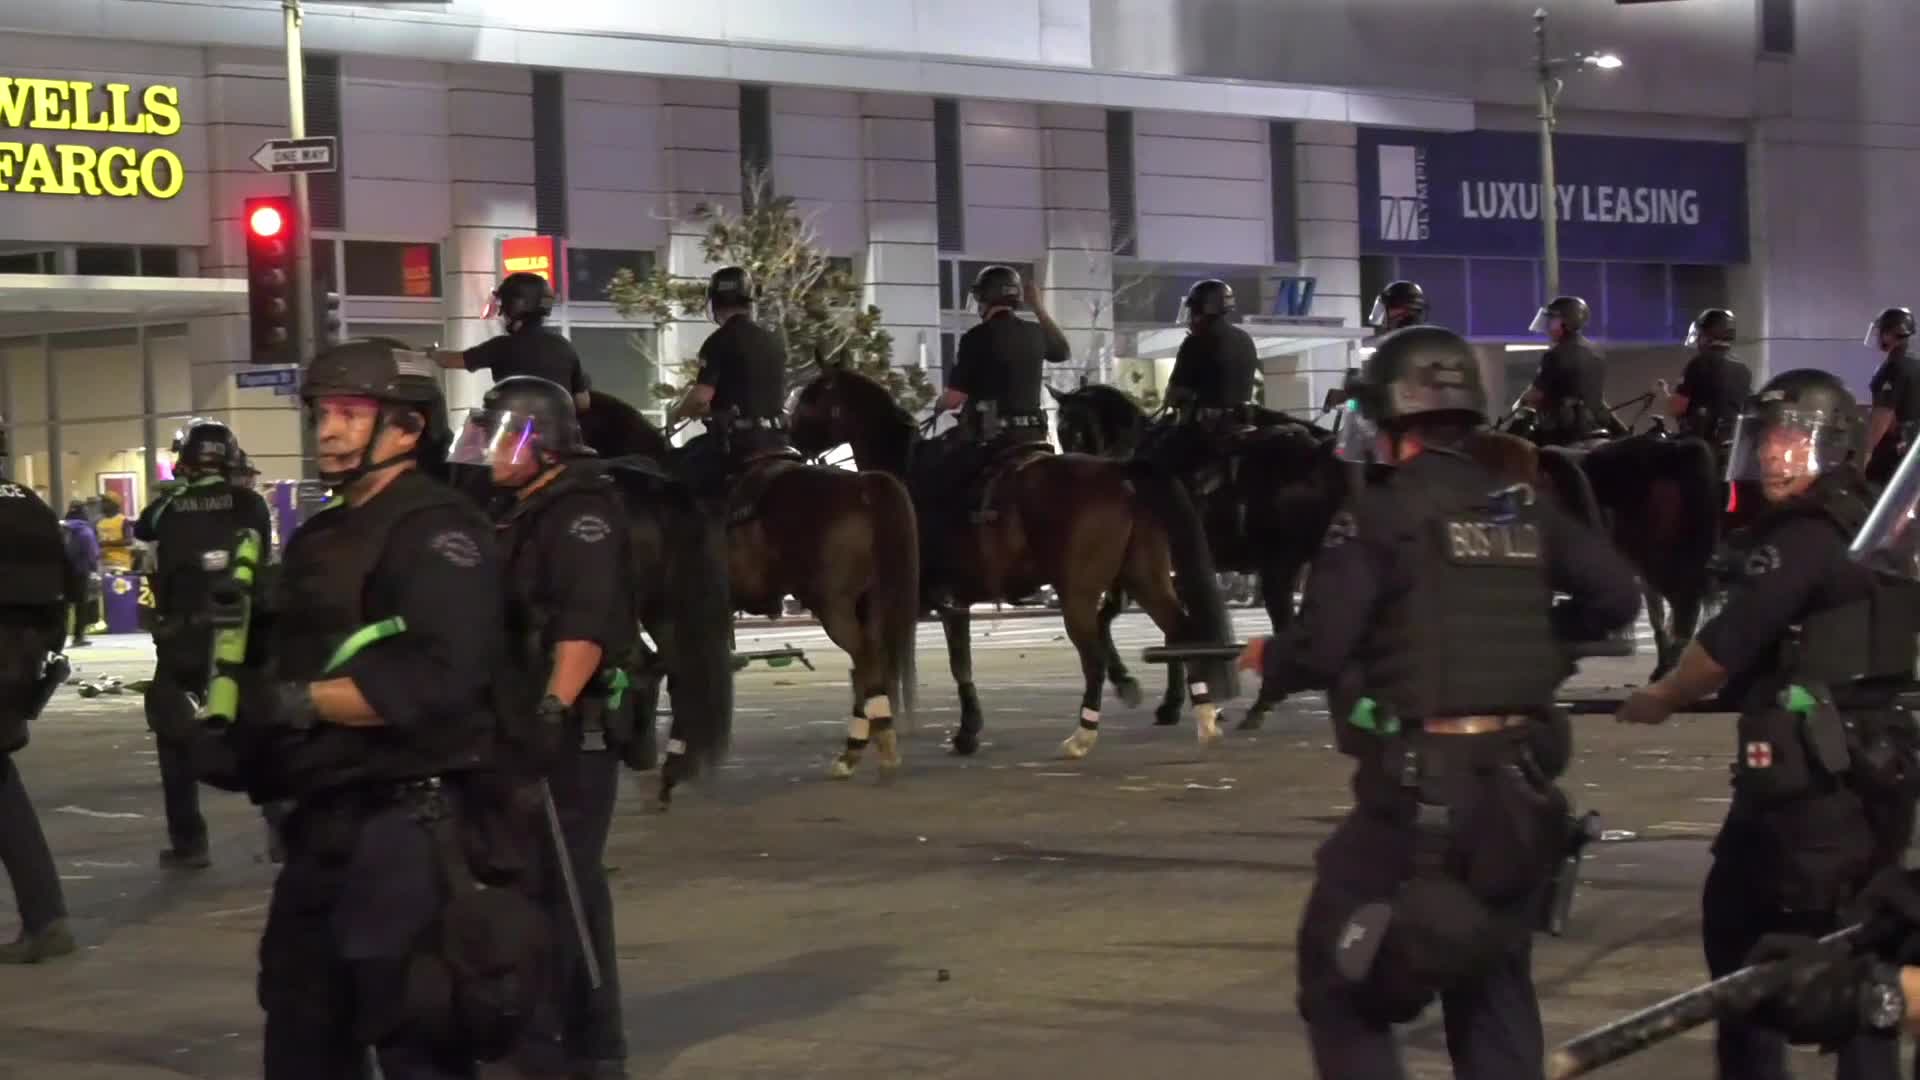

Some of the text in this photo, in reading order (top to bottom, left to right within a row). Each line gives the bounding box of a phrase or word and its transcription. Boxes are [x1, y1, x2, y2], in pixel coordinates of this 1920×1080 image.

[0, 77, 181, 136] WELLS
[0, 142, 184, 199] FARGO
[273, 149, 326, 162] ONE WAY
[1582, 185, 1700, 225] LEASING
